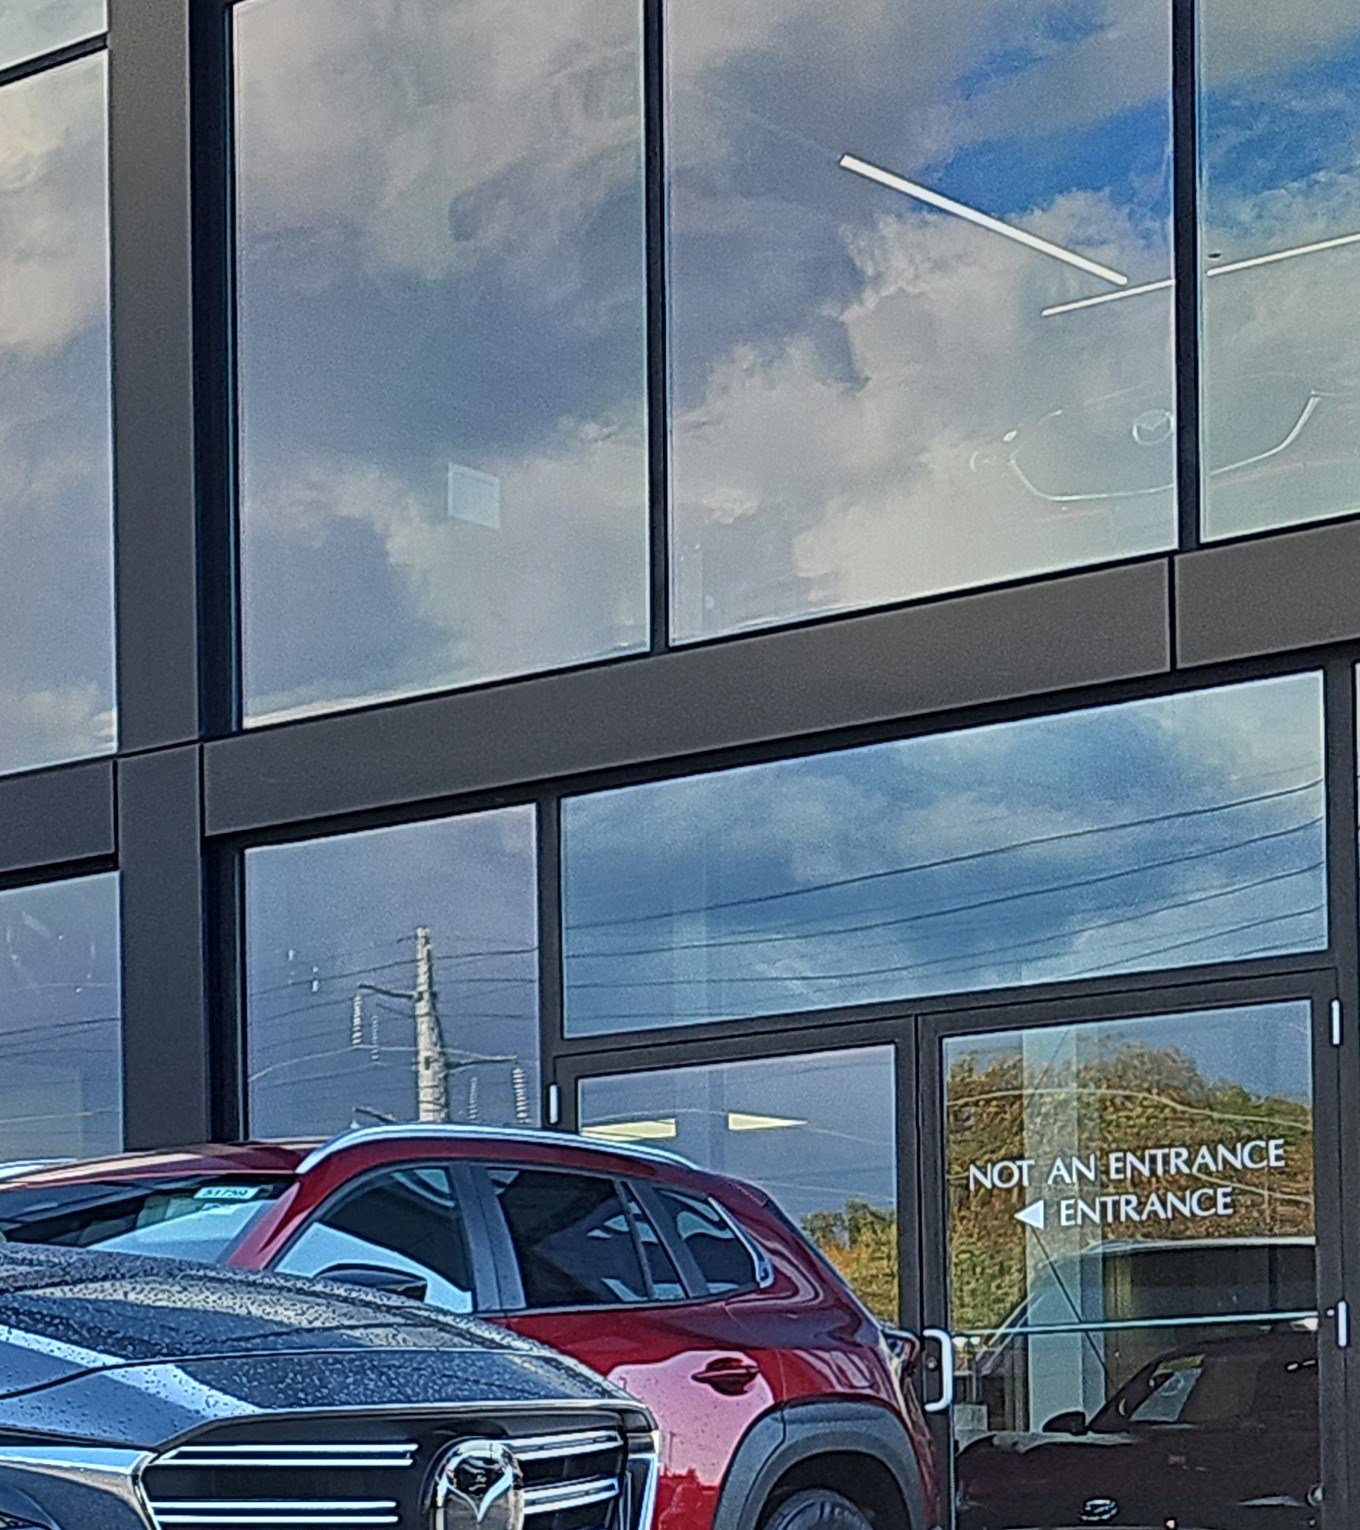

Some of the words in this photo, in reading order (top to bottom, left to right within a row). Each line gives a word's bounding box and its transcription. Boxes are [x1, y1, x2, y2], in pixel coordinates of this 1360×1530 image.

[969, 1159, 1035, 1190] NOT
[1047, 1153, 1098, 1185] AN
[1109, 1138, 1286, 1179] ENTRANCE
[1059, 1186, 1234, 1227] ENTRANCE
